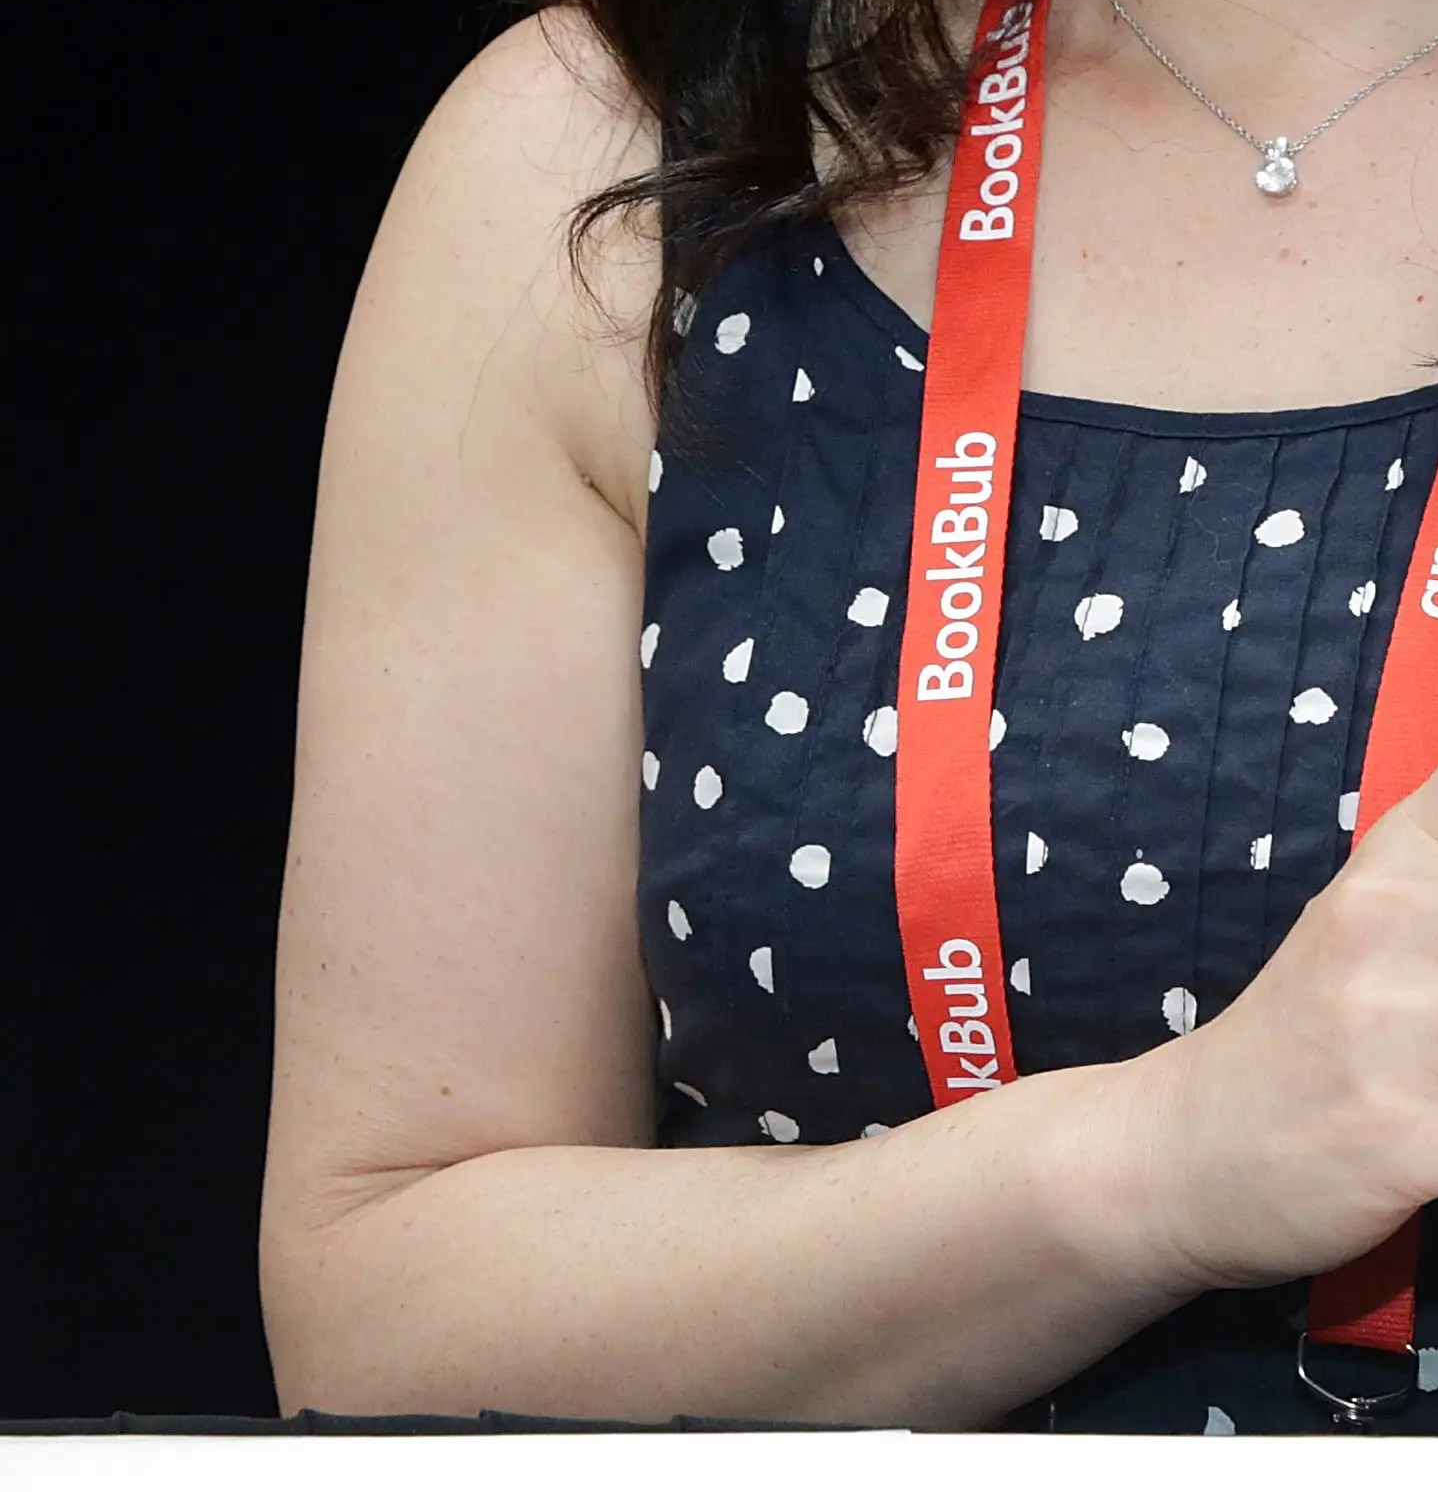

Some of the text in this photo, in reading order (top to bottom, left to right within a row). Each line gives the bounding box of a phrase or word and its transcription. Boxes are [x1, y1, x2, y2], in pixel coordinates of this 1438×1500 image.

[960, 1, 1034, 242] BookBub
[916, 431, 998, 702] BookBub
[922, 938, 1002, 1089] kBub
